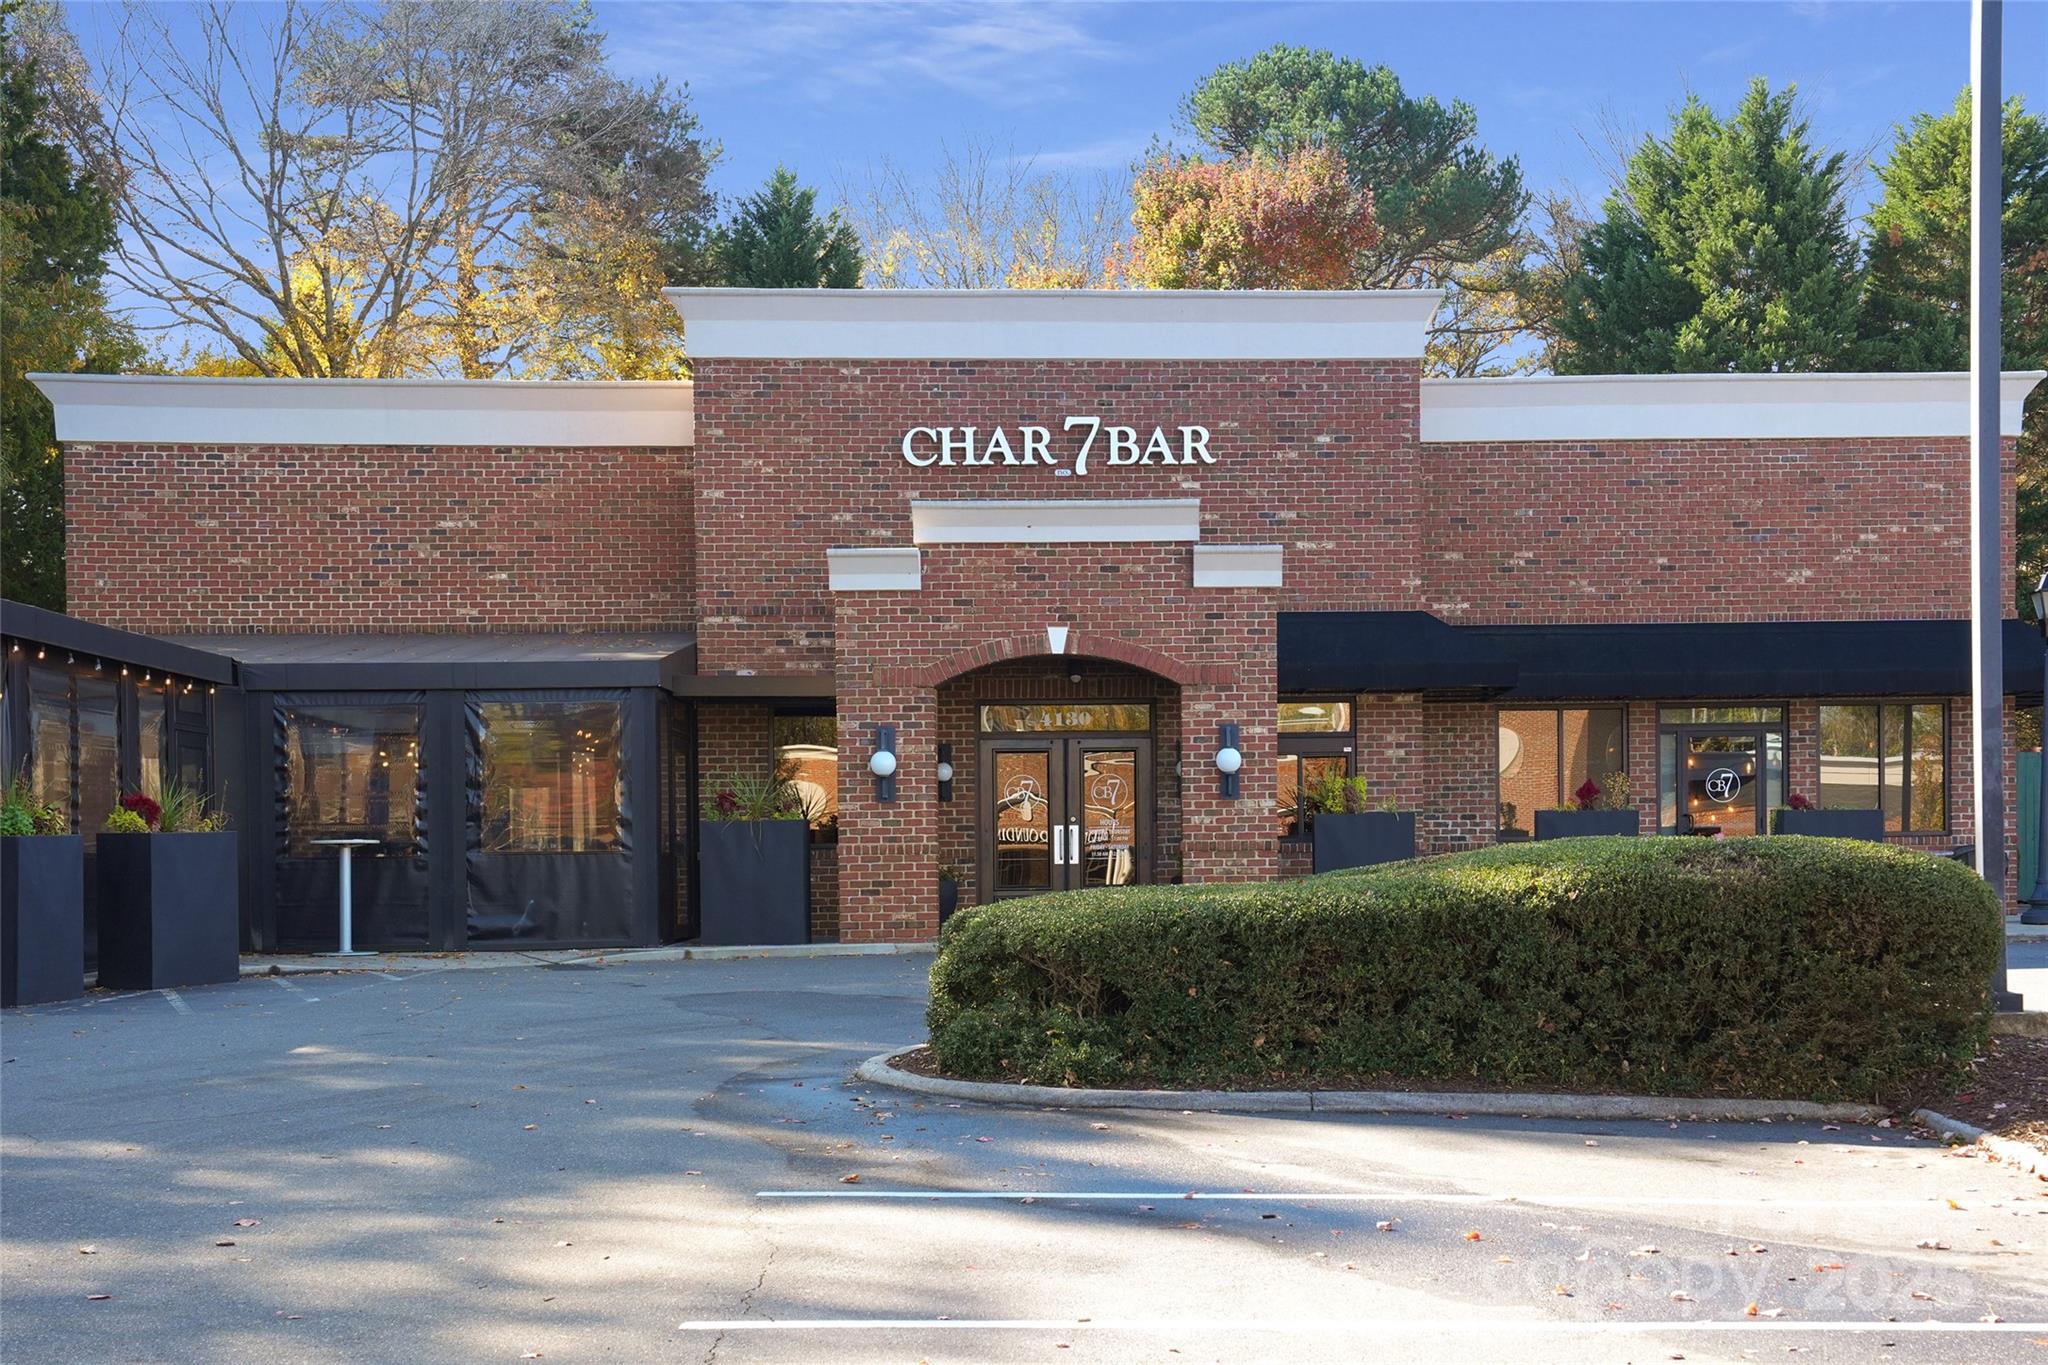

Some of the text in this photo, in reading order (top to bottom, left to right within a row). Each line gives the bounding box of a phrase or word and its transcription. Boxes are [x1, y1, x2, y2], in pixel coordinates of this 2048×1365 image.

[902, 416, 1217, 476] CHAR 7 BAR
[1040, 711, 1092, 727] 4130
